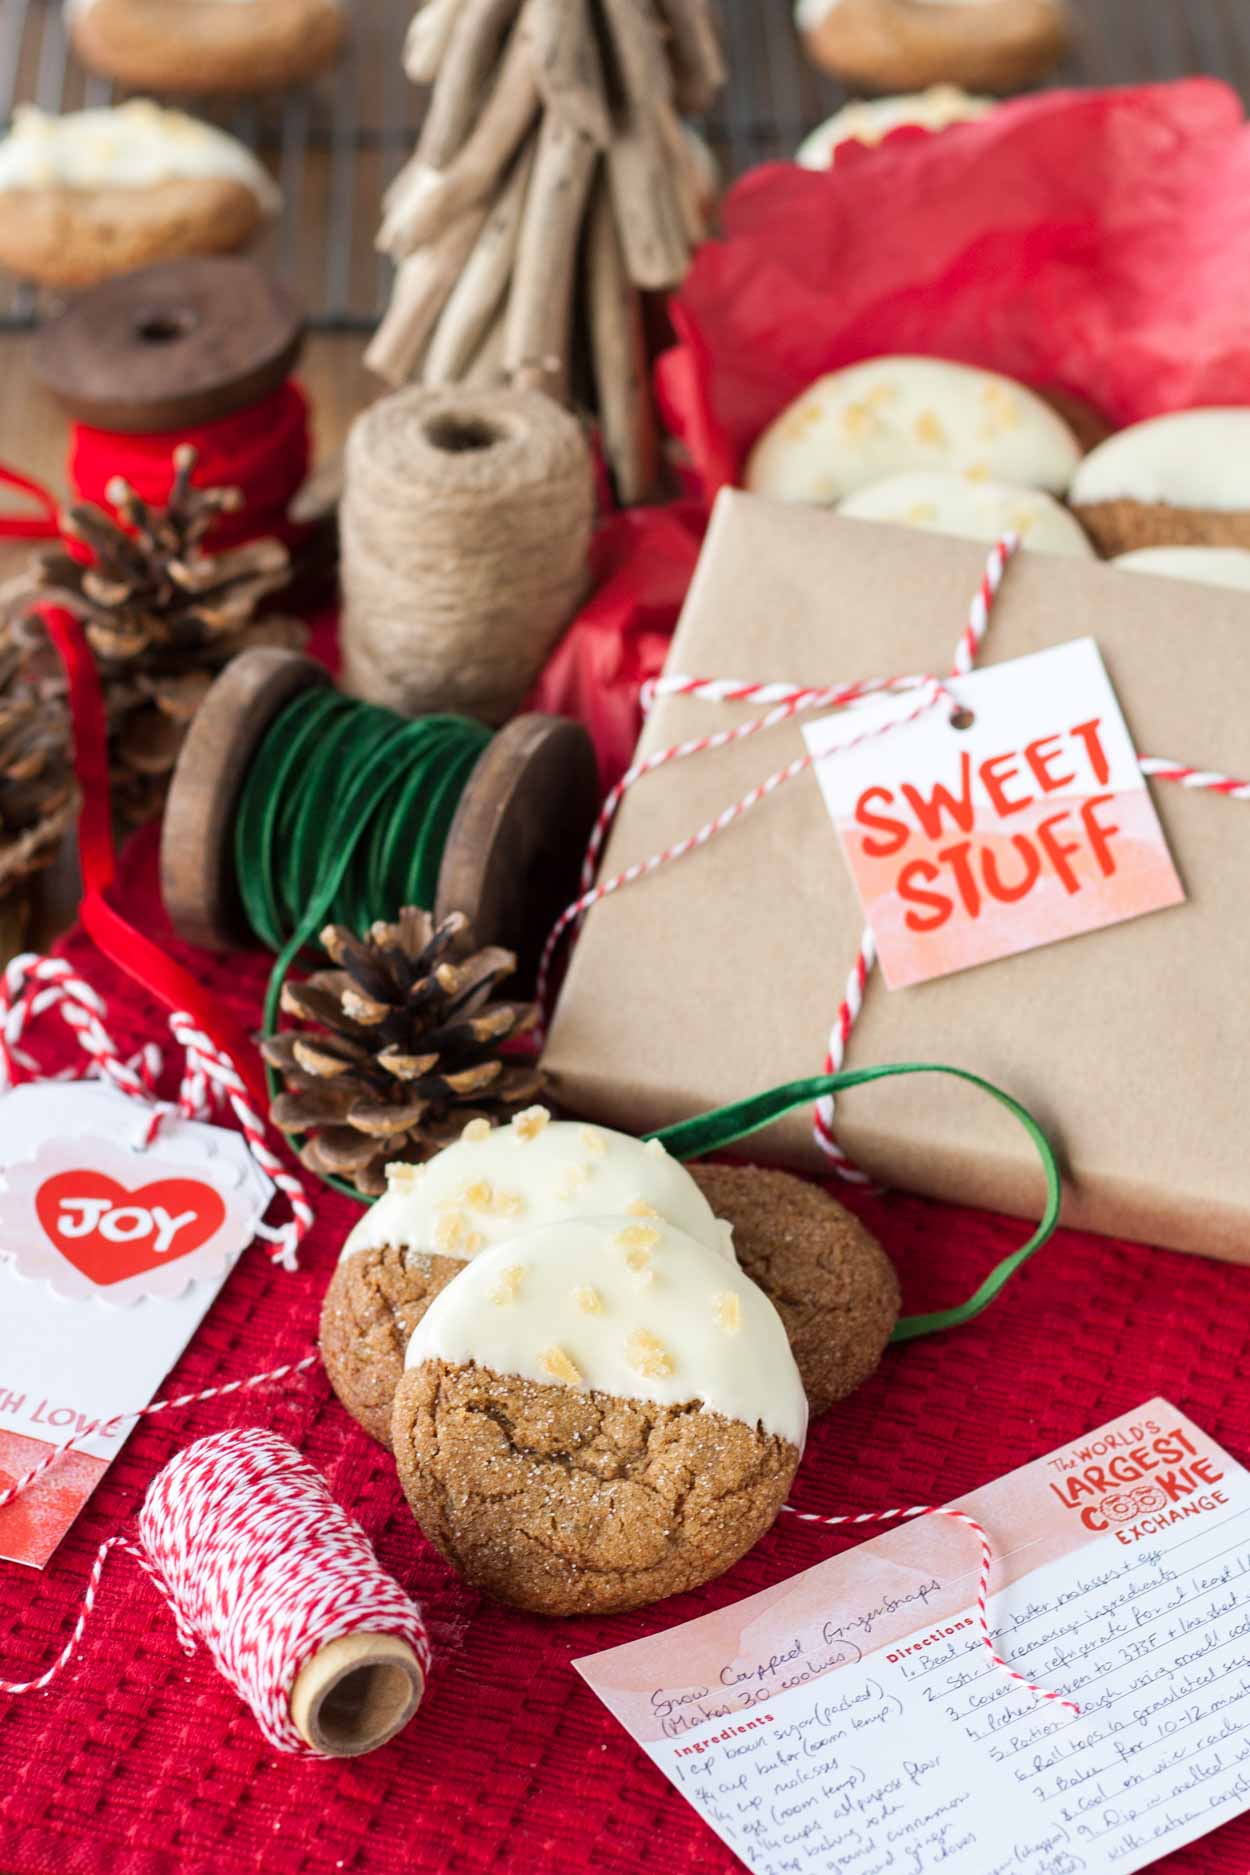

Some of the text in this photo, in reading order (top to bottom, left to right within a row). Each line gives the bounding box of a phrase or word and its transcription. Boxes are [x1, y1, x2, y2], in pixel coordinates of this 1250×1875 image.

[855, 718, 1110, 858] SWEET
[896, 794, 1120, 933] STUFF
[57, 1197, 198, 1252] JOY
[30, 1399, 119, 1437] LOVE
[1049, 1419, 1161, 1473] The WORLD'S
[1050, 1428, 1197, 1509] LARGEST
[1115, 1489, 1230, 1546] EXCHANGE
[886, 1617, 974, 1664] Directions
[651, 1688, 709, 1718] Snow
[720, 1638, 804, 1686] Capped
[738, 1688, 771, 1710] 30
[674, 1714, 774, 1758] Ingredients
